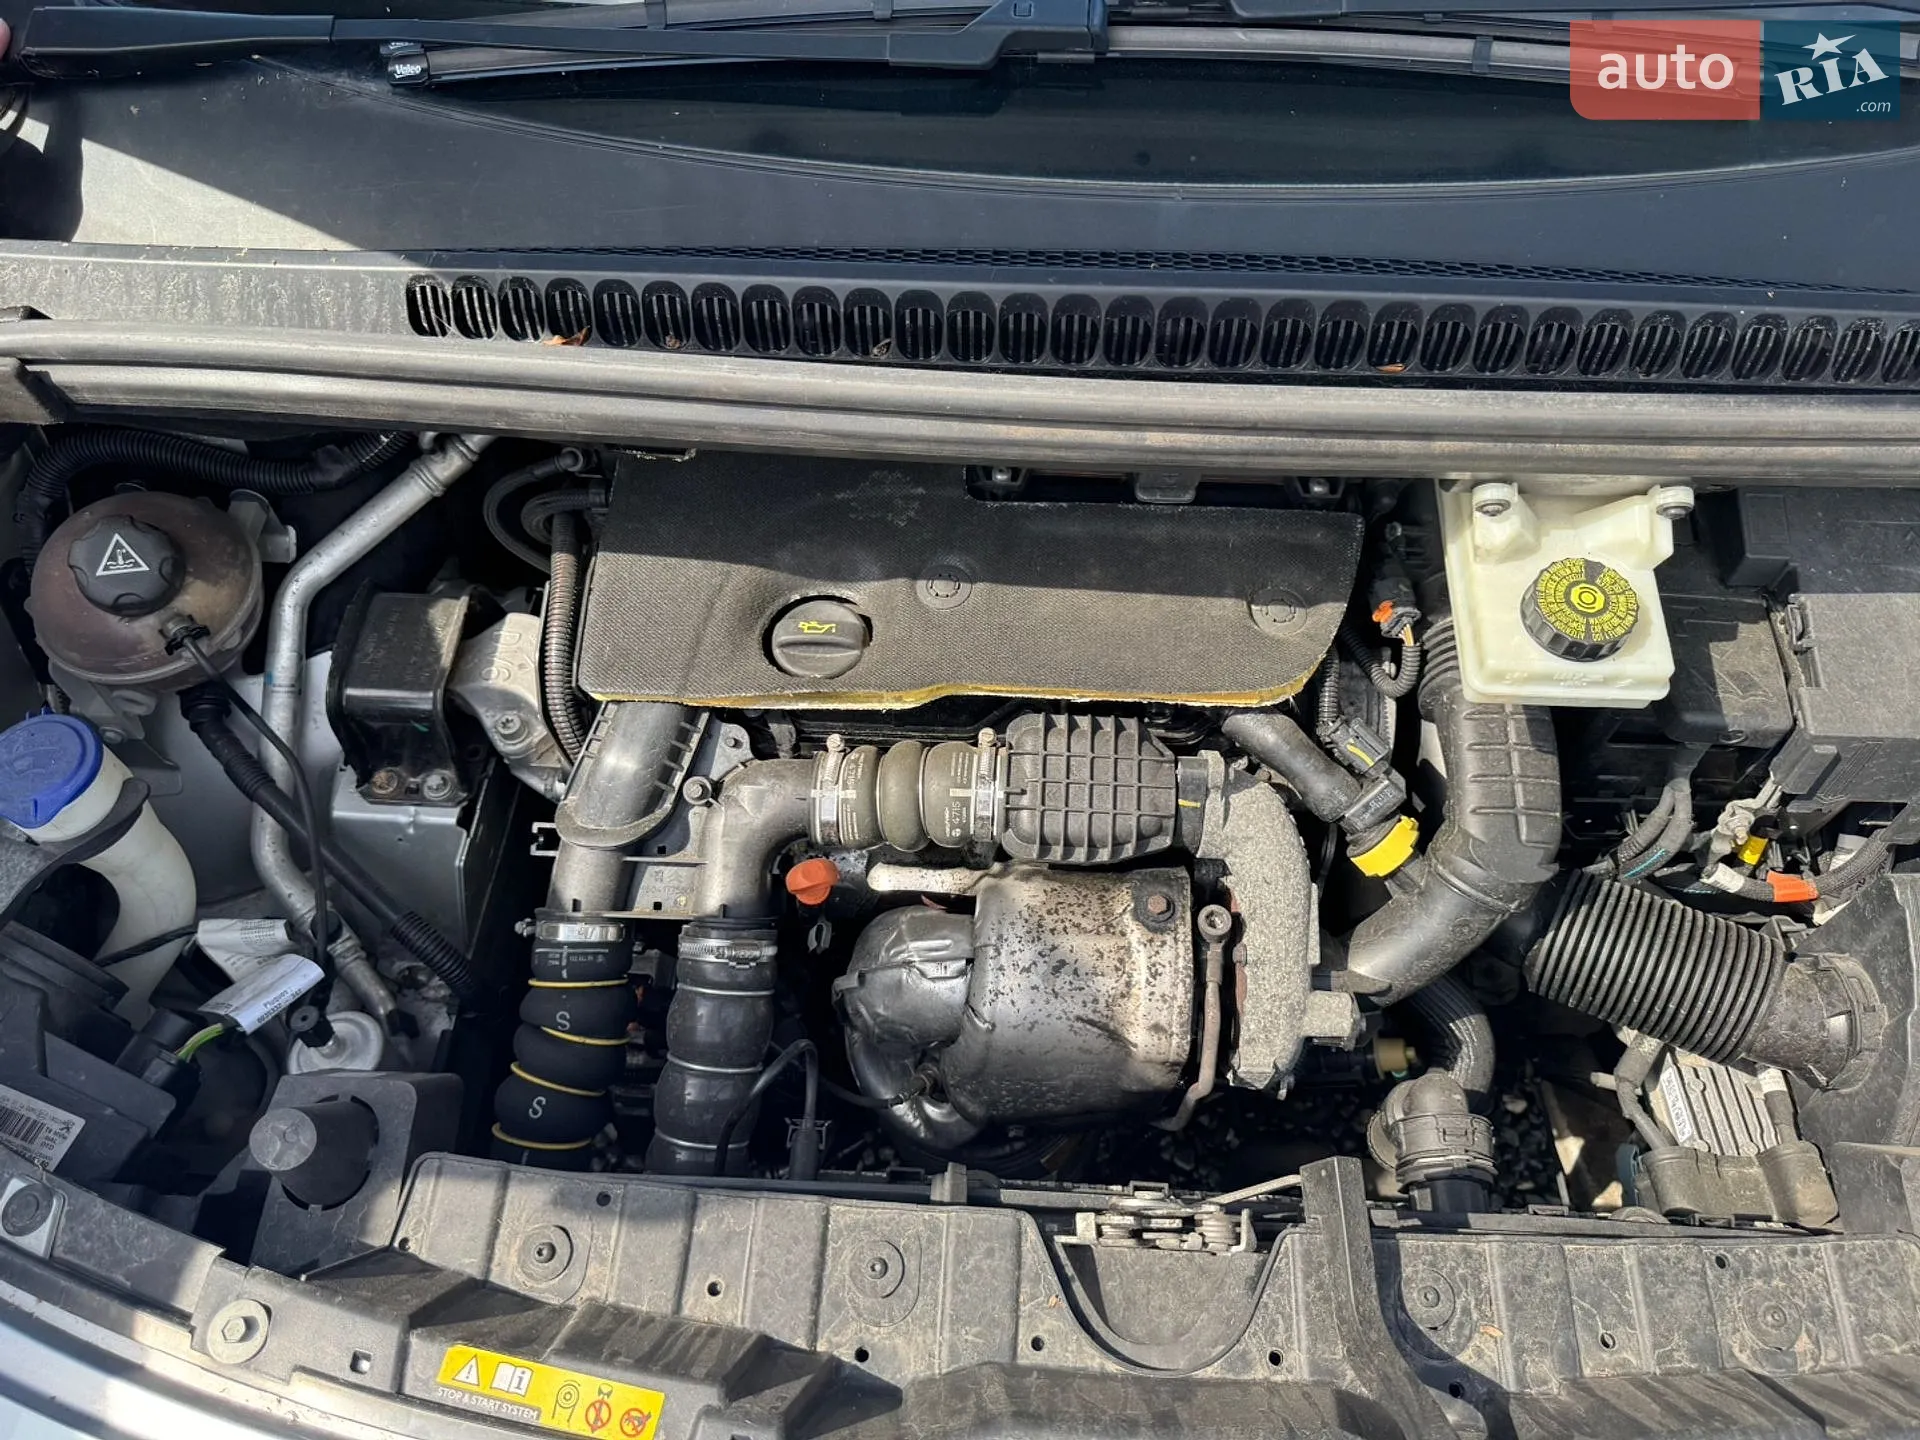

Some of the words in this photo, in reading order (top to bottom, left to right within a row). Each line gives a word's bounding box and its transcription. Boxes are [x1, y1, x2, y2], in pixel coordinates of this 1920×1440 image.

[395, 64, 421, 75] Valeo
[555, 1011, 570, 1031] S
[528, 1096, 546, 1119] S
[438, 1387, 463, 1402] STOP
[471, 1395, 502, 1411] START
[502, 1403, 538, 1420] SYSTEM
